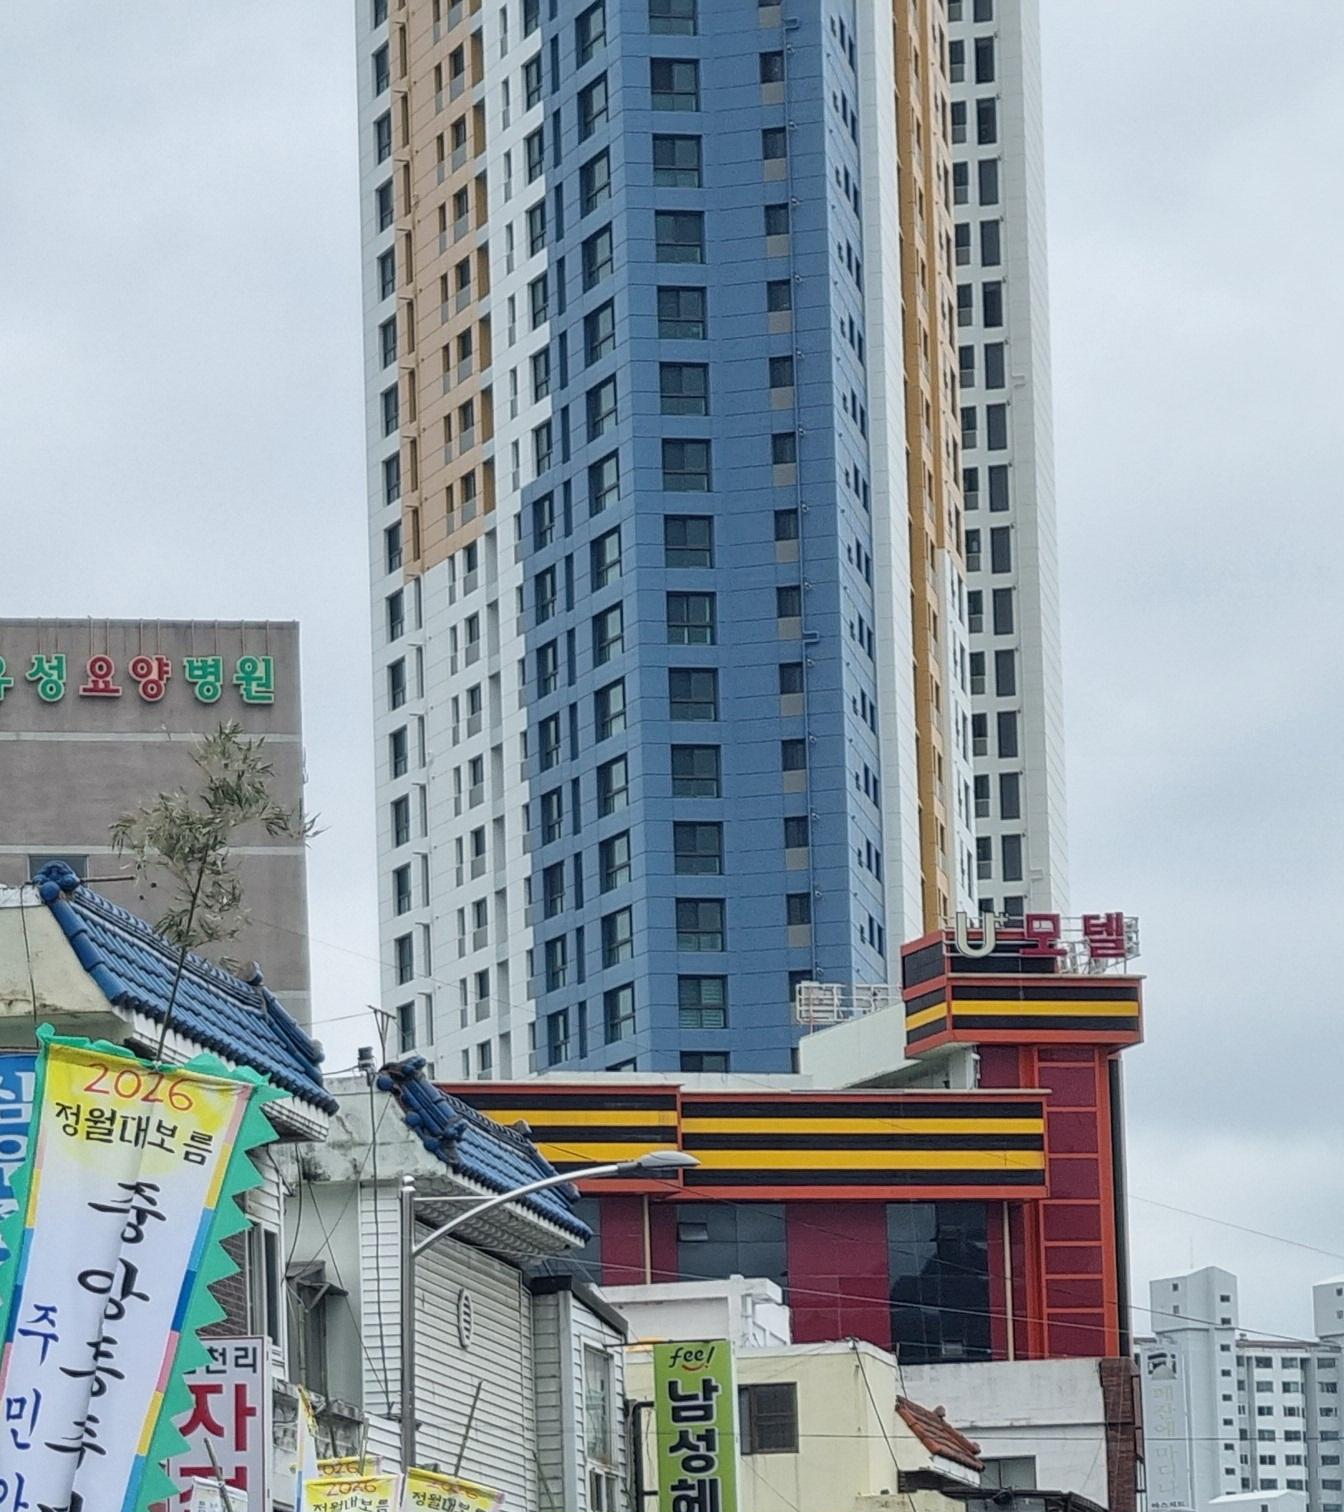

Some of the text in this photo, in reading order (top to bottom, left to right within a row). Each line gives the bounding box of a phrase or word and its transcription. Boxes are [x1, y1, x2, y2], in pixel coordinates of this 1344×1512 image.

[84, 1063, 194, 1112] 2026
[55, 1102, 214, 1166] 정월대보름
[185, 1346, 258, 1375] 천리
